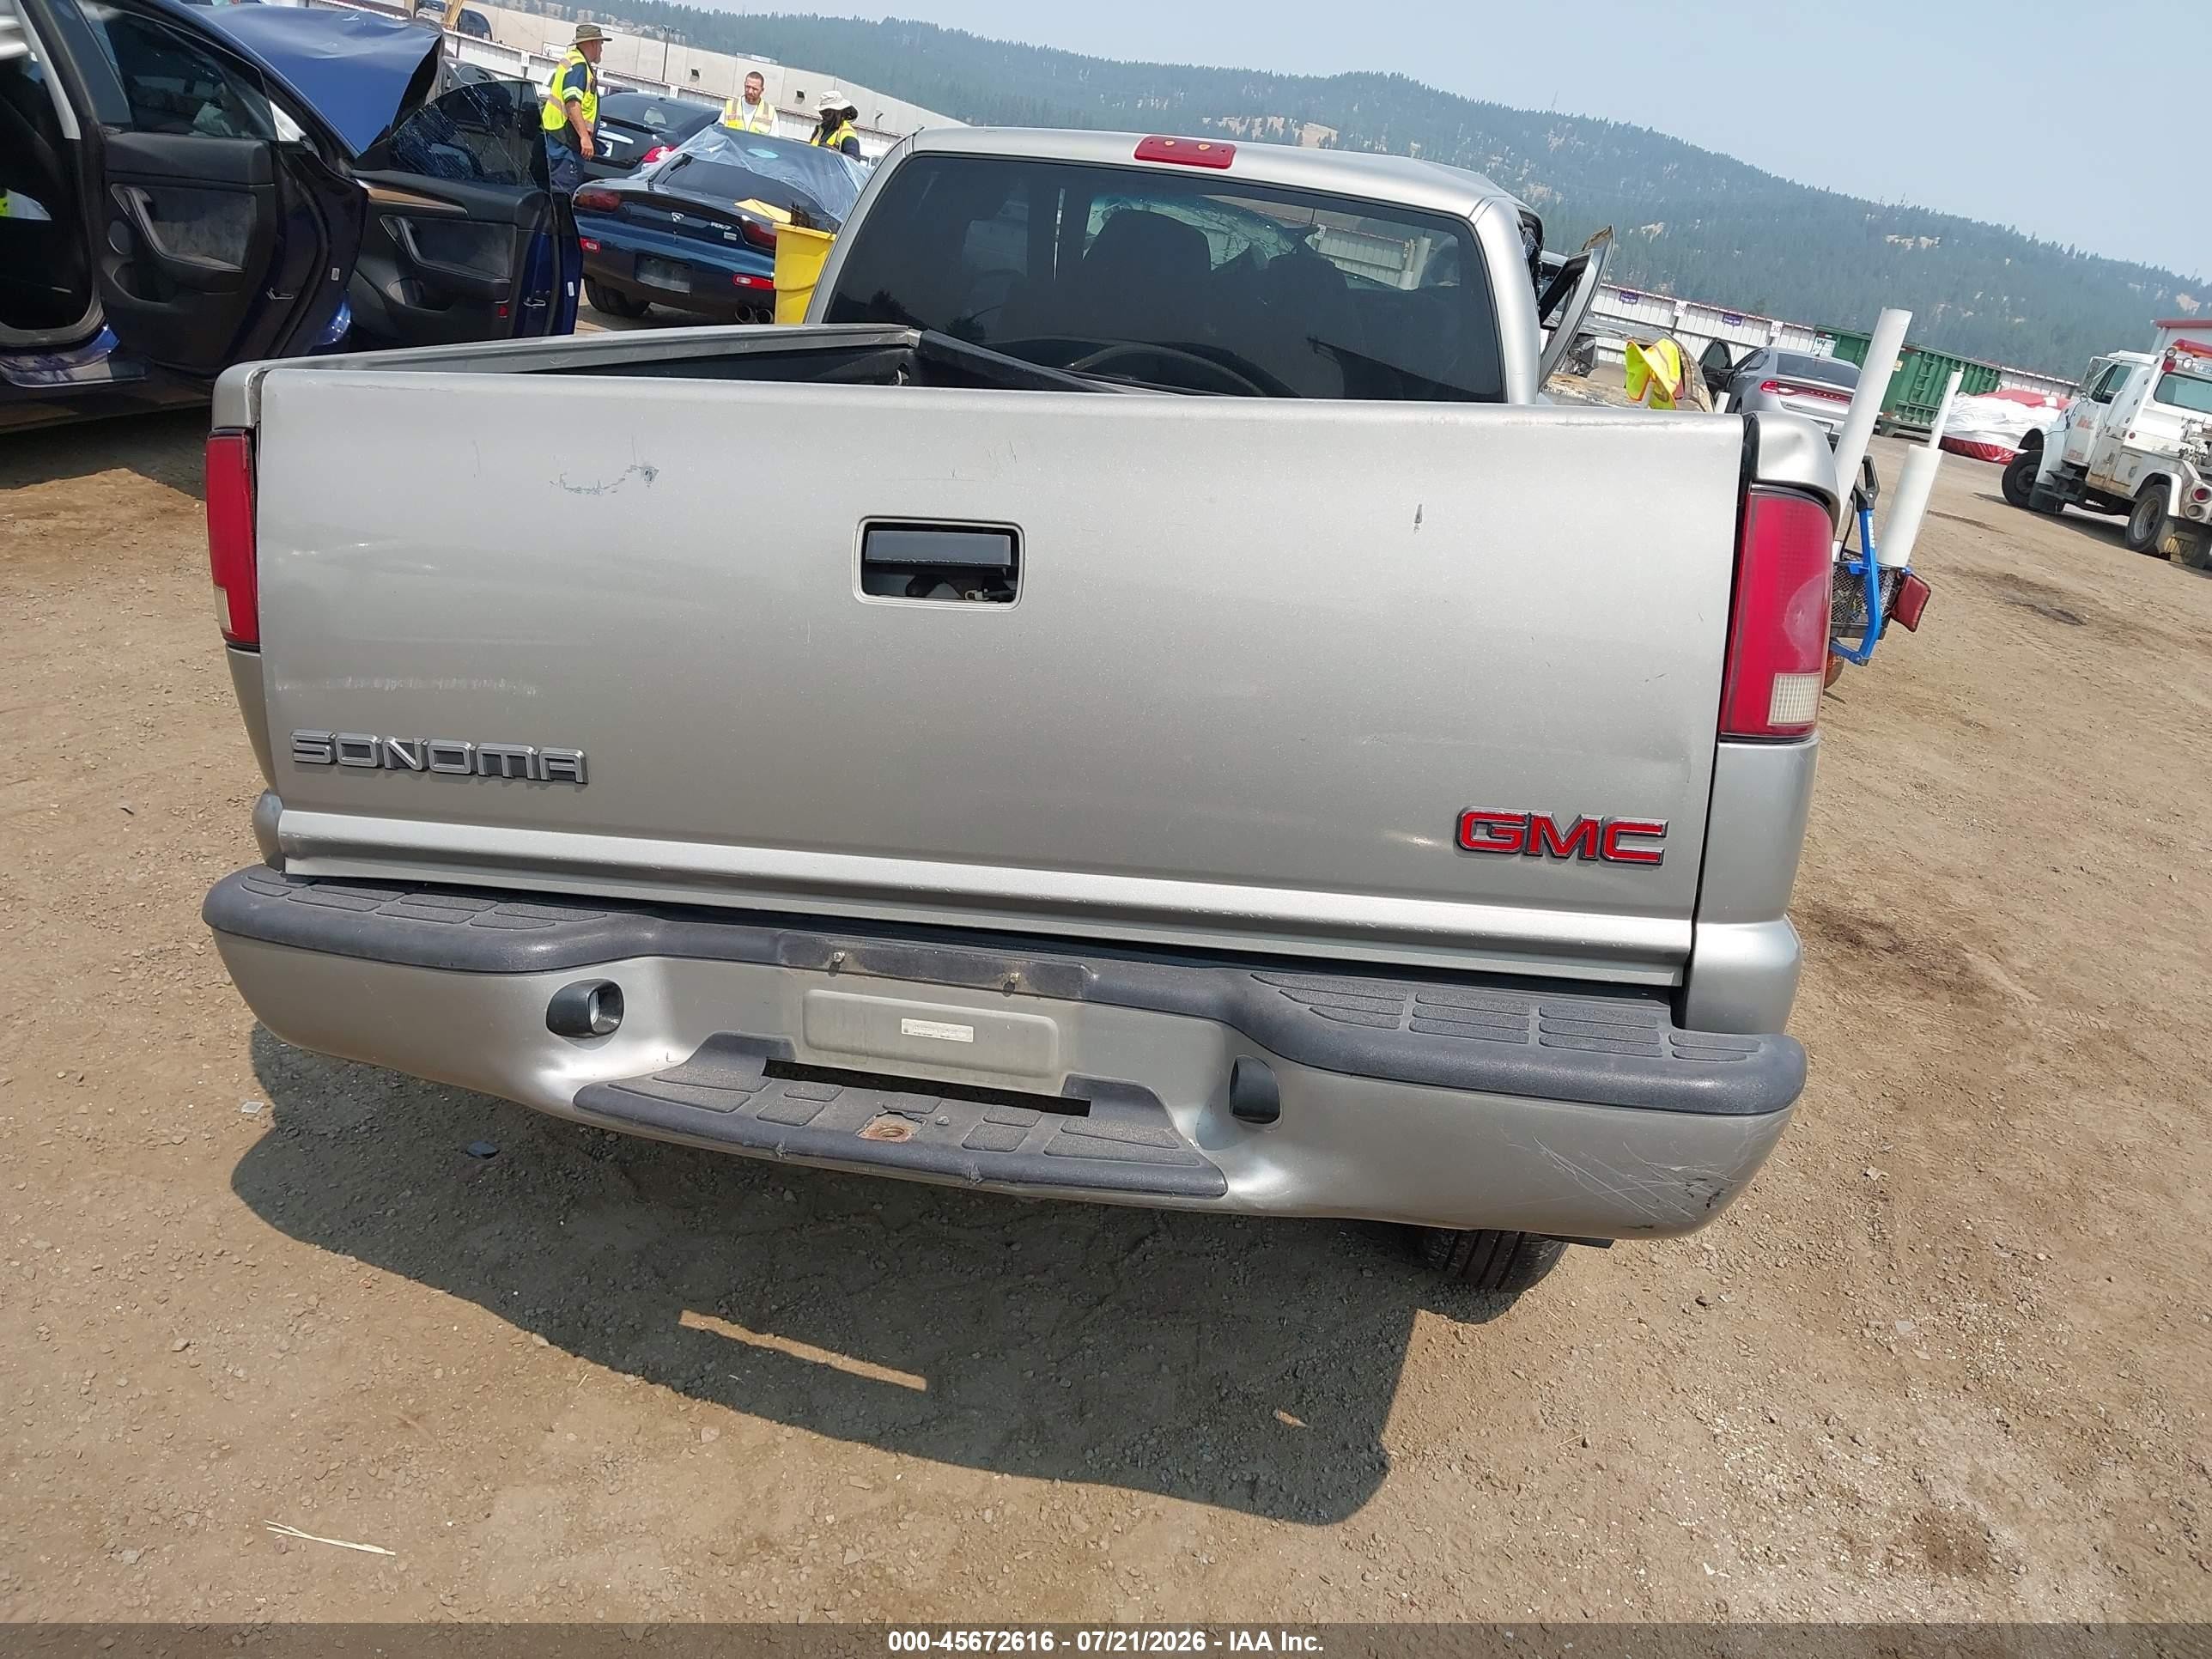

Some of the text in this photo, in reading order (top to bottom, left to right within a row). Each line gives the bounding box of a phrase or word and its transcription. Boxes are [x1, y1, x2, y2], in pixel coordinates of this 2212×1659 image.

[1674, 304, 1686, 313] 29
[1771, 325, 1782, 333] 30
[289, 728, 589, 785] SONOMA
[1455, 805, 1669, 866] GMC
